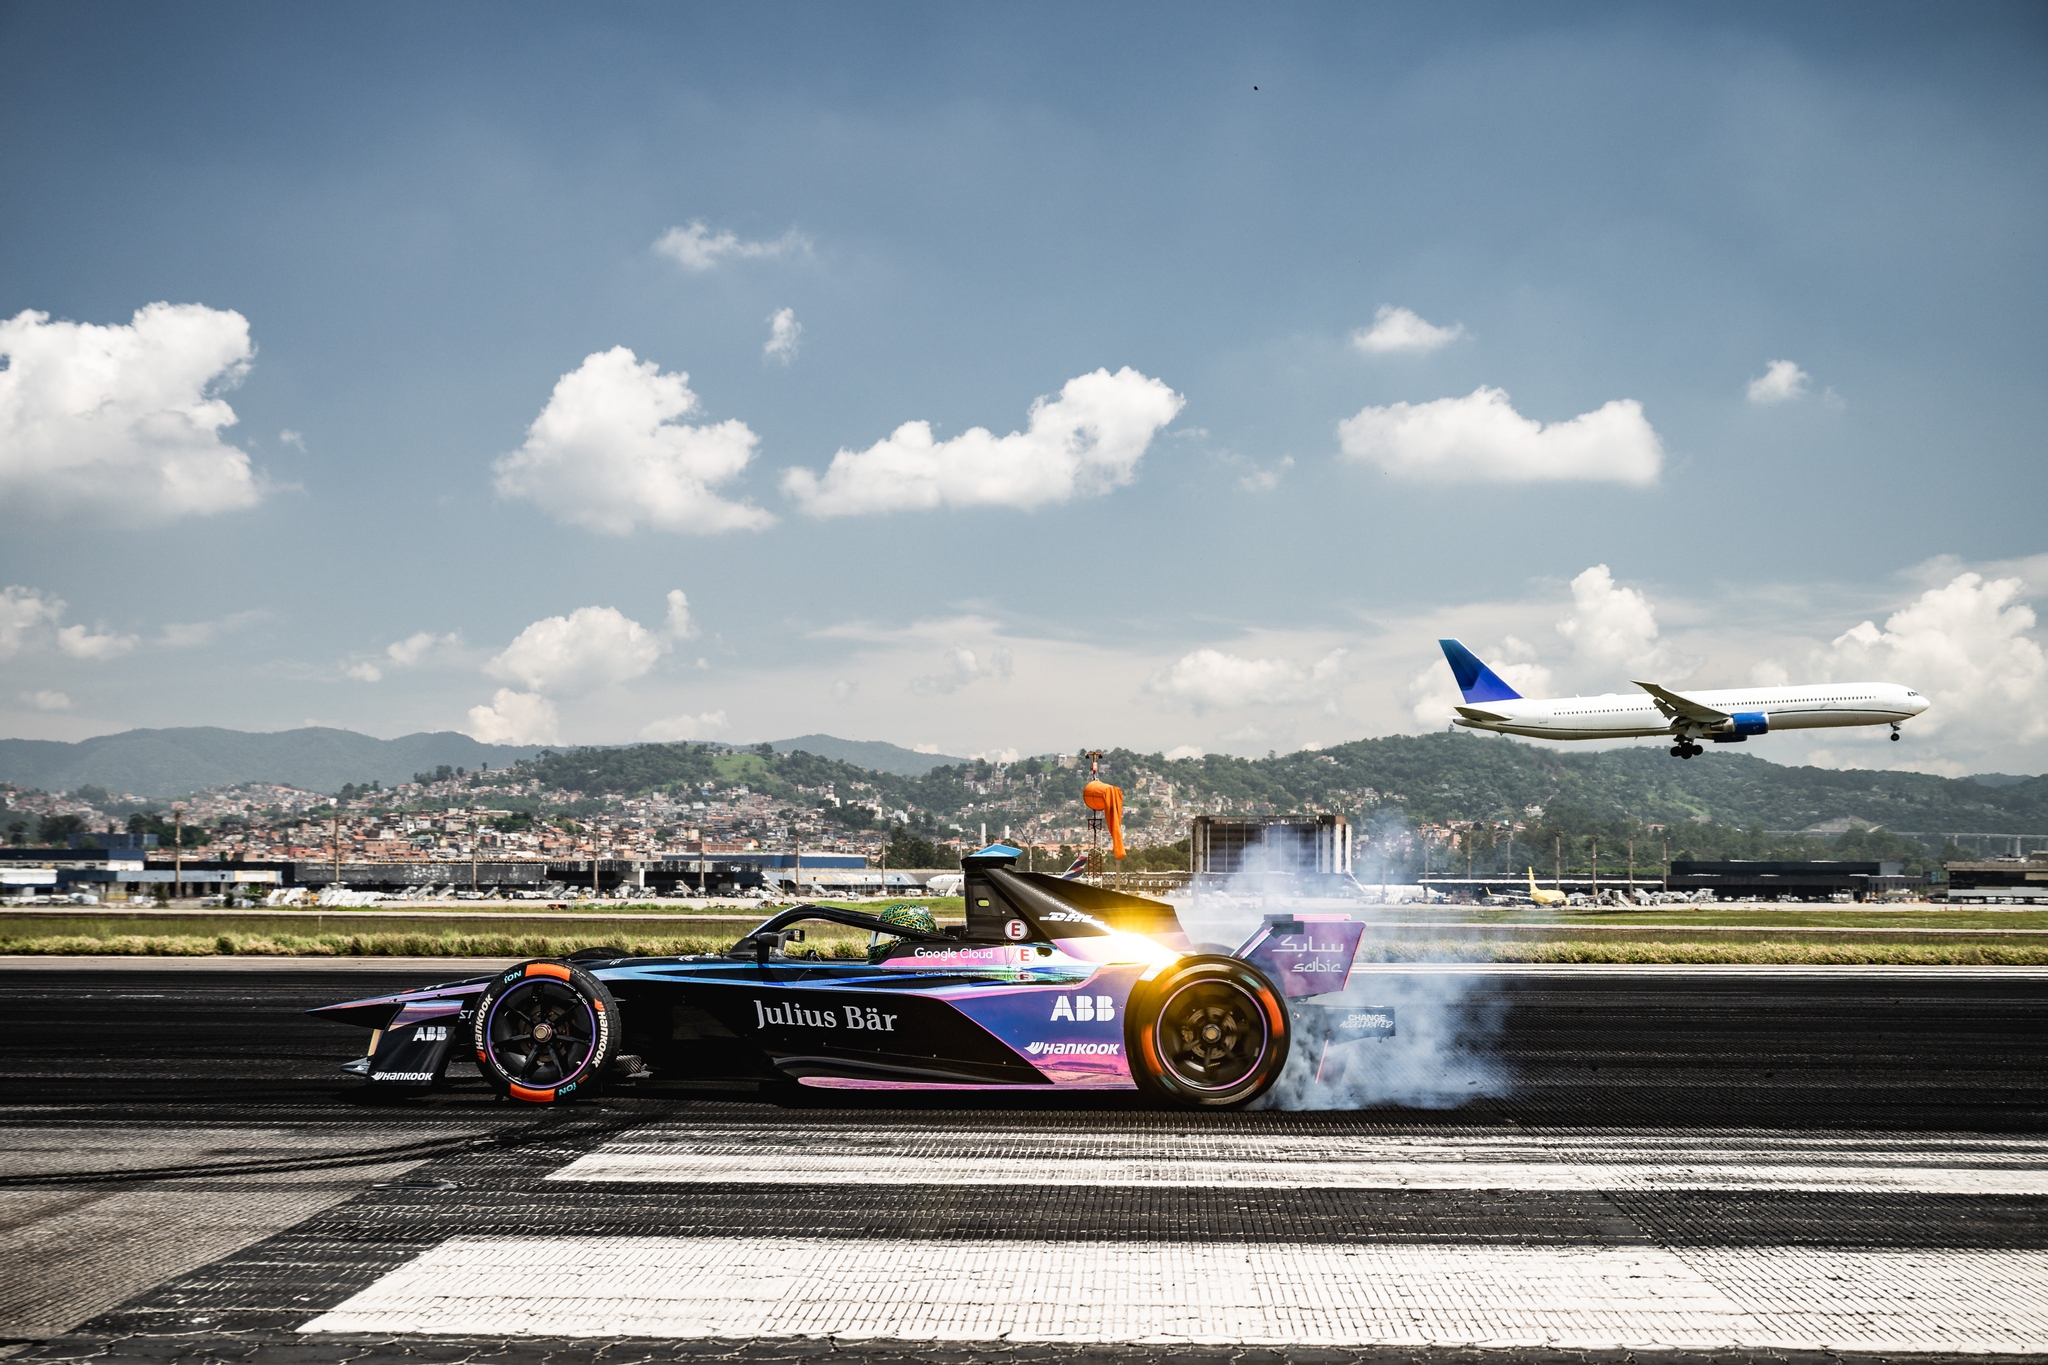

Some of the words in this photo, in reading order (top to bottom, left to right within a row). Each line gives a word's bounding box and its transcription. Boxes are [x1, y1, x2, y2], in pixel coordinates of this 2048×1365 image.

[1049, 911, 1096, 924] DHL
[1011, 923, 1021, 937] E
[914, 947, 957, 962] Google
[959, 948, 993, 959] Cloud
[1271, 936, 1344, 958] سابك
[1020, 949, 1030, 961] E
[1291, 956, 1343, 973] sabic
[753, 1000, 837, 1029] Julius
[843, 1005, 897, 1031] Bär
[1050, 995, 1115, 1021] ABB
[1339, 1020, 1393, 1029] ACCELERATED
[412, 1026, 447, 1041] ABB
